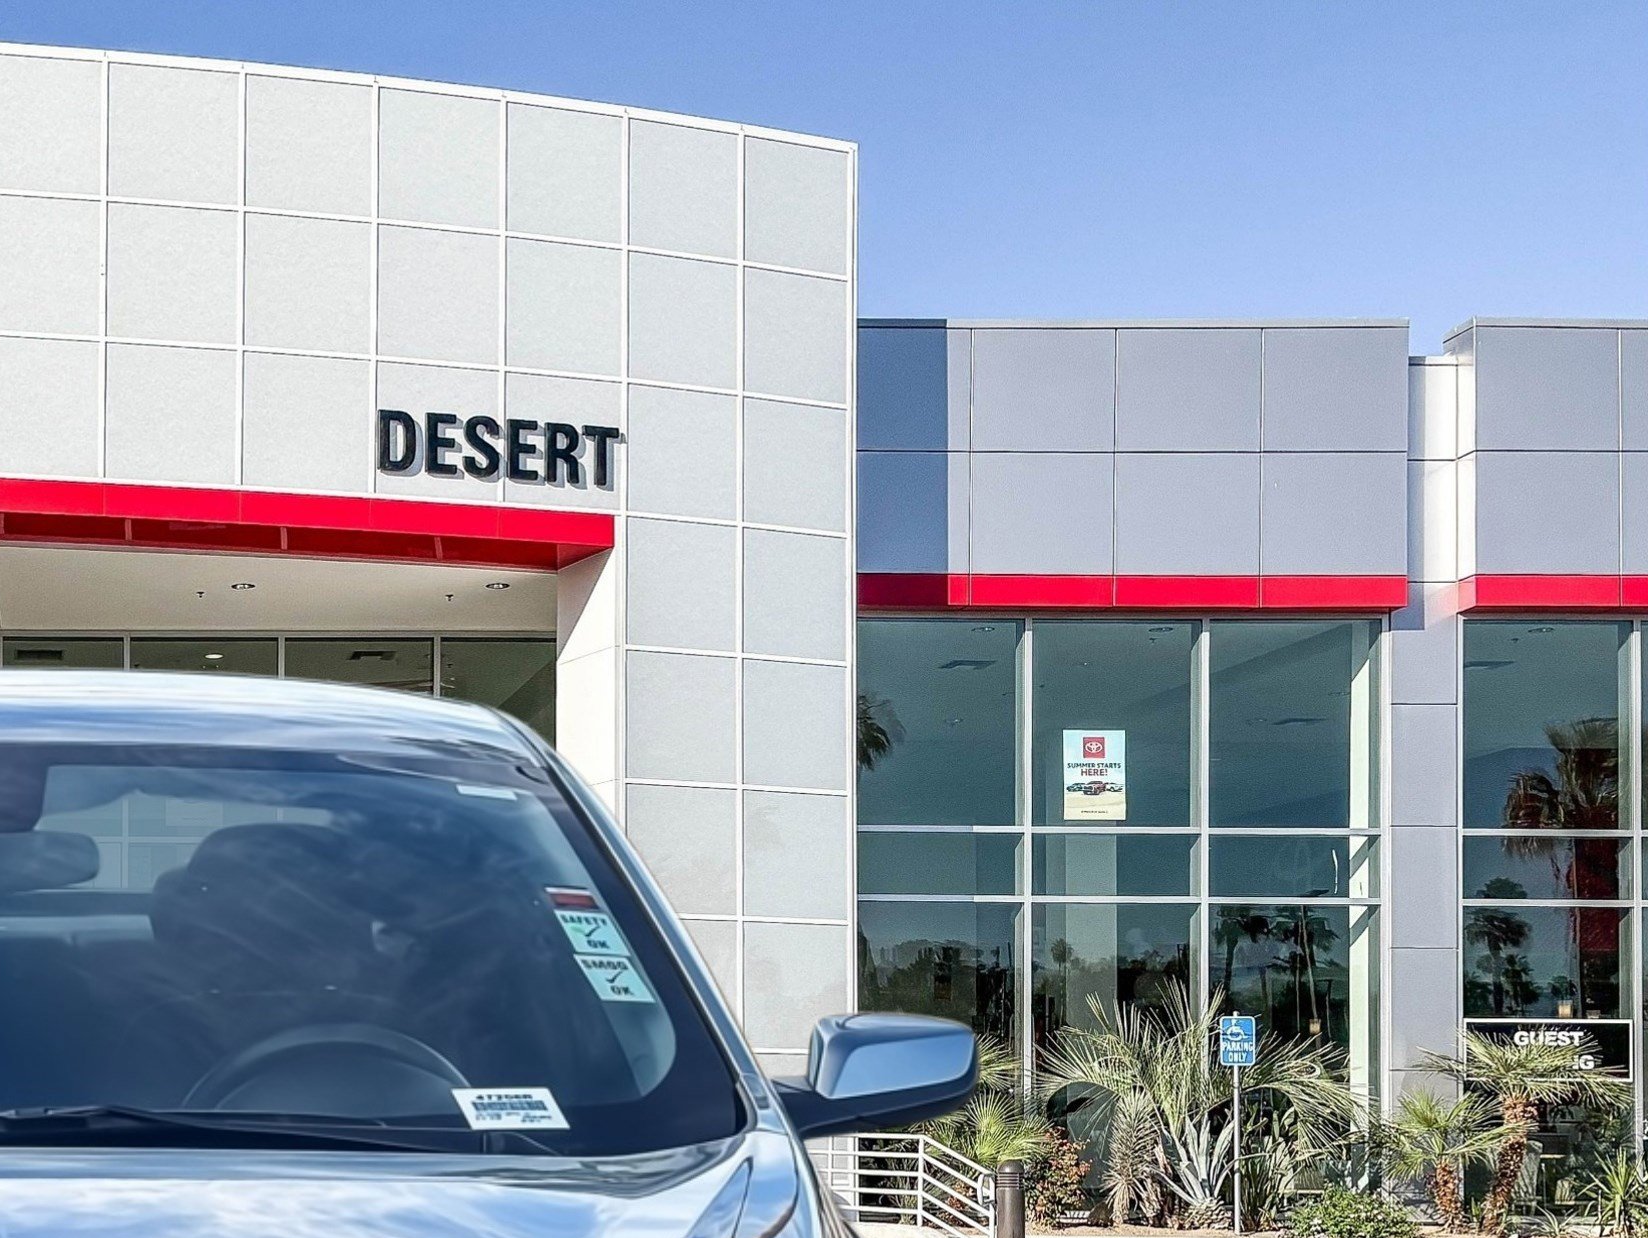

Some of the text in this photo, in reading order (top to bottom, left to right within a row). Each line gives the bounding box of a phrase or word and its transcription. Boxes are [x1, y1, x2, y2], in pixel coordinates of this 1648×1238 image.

[376, 408, 620, 487] DESERT
[1080, 768, 1109, 777] HERE!
[1513, 1030, 1585, 1047] GUEST
[1222, 1041, 1254, 1051] PARKING
[1228, 1051, 1248, 1063] ONLY
